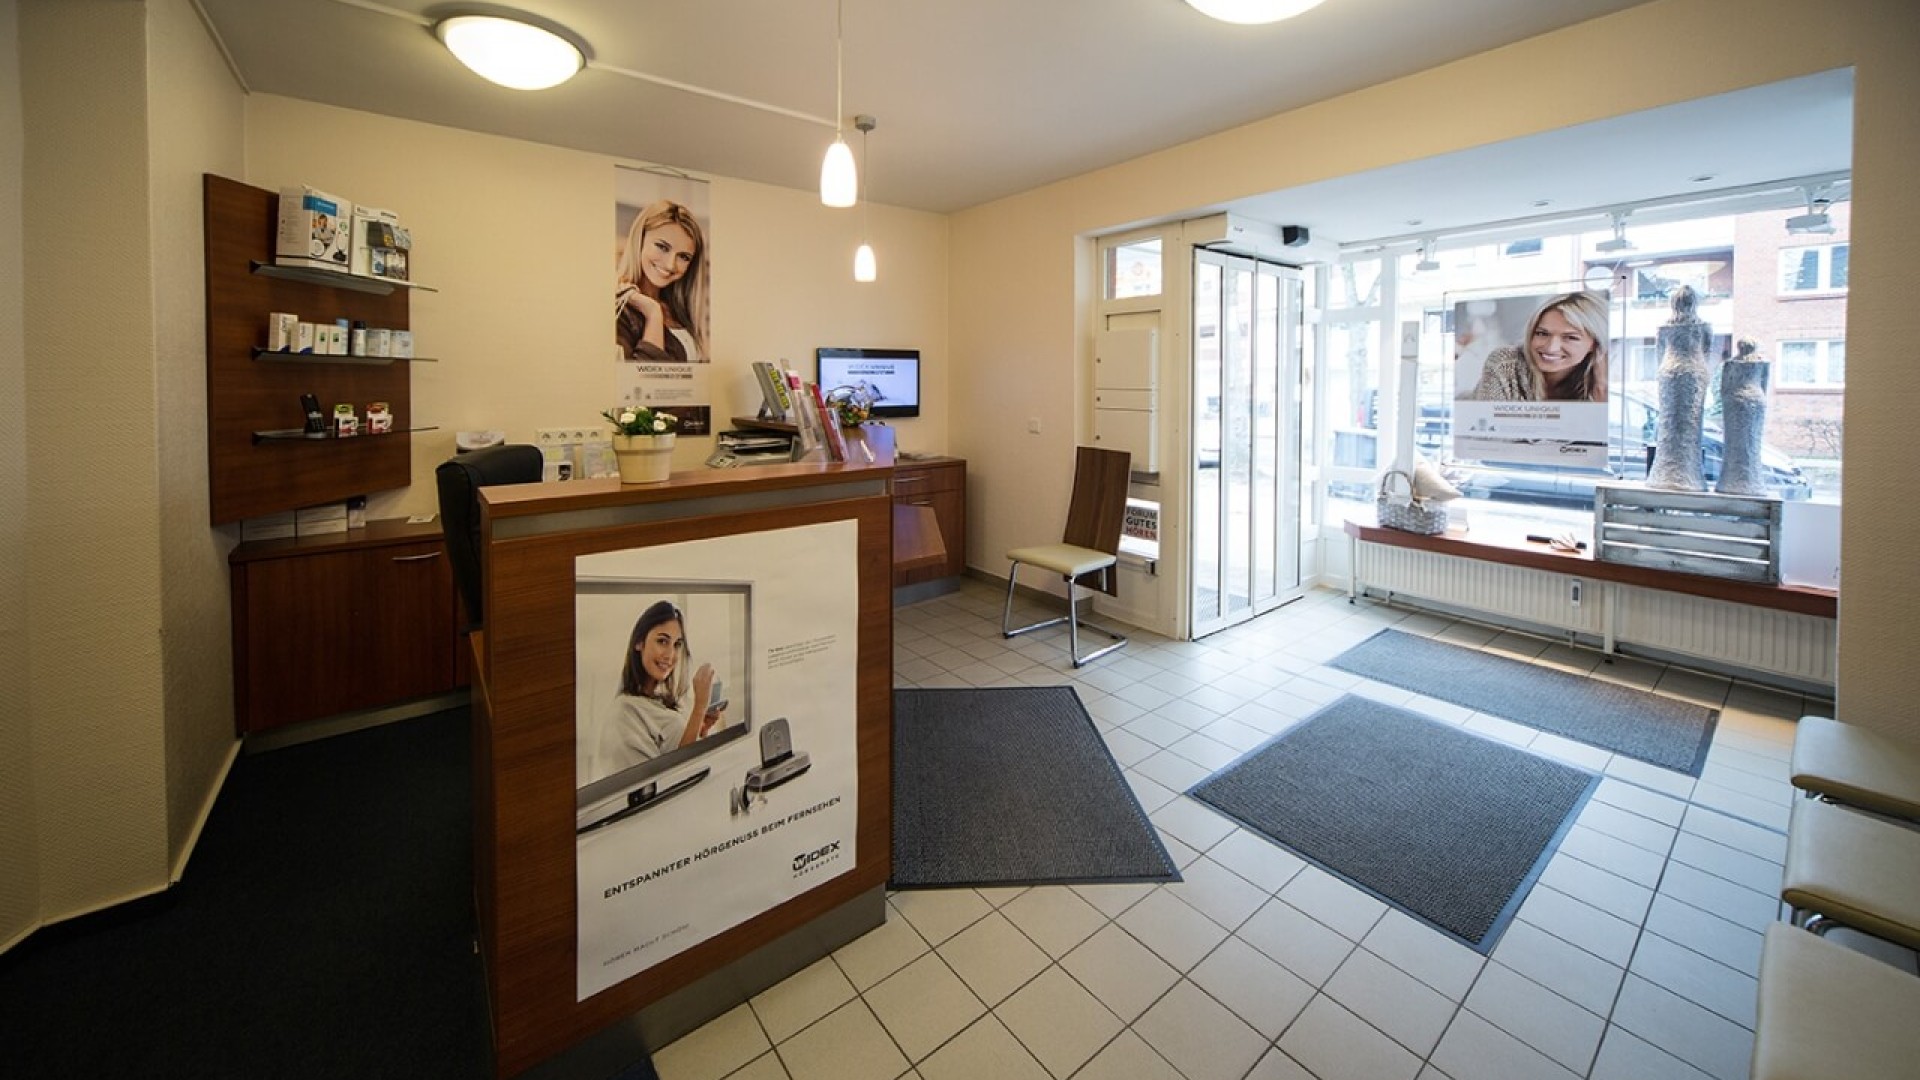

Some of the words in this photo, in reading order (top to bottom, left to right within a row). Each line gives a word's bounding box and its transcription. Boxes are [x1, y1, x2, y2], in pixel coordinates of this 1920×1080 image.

[1126, 517, 1157, 530] GUTES
[604, 857, 691, 899] ENTSPANNTER
[694, 829, 759, 861] HÖRGENUSS
[761, 818, 786, 835] BEIM
[788, 796, 841, 823] FERNSEHEN
[792, 840, 841, 871] WIDEX
